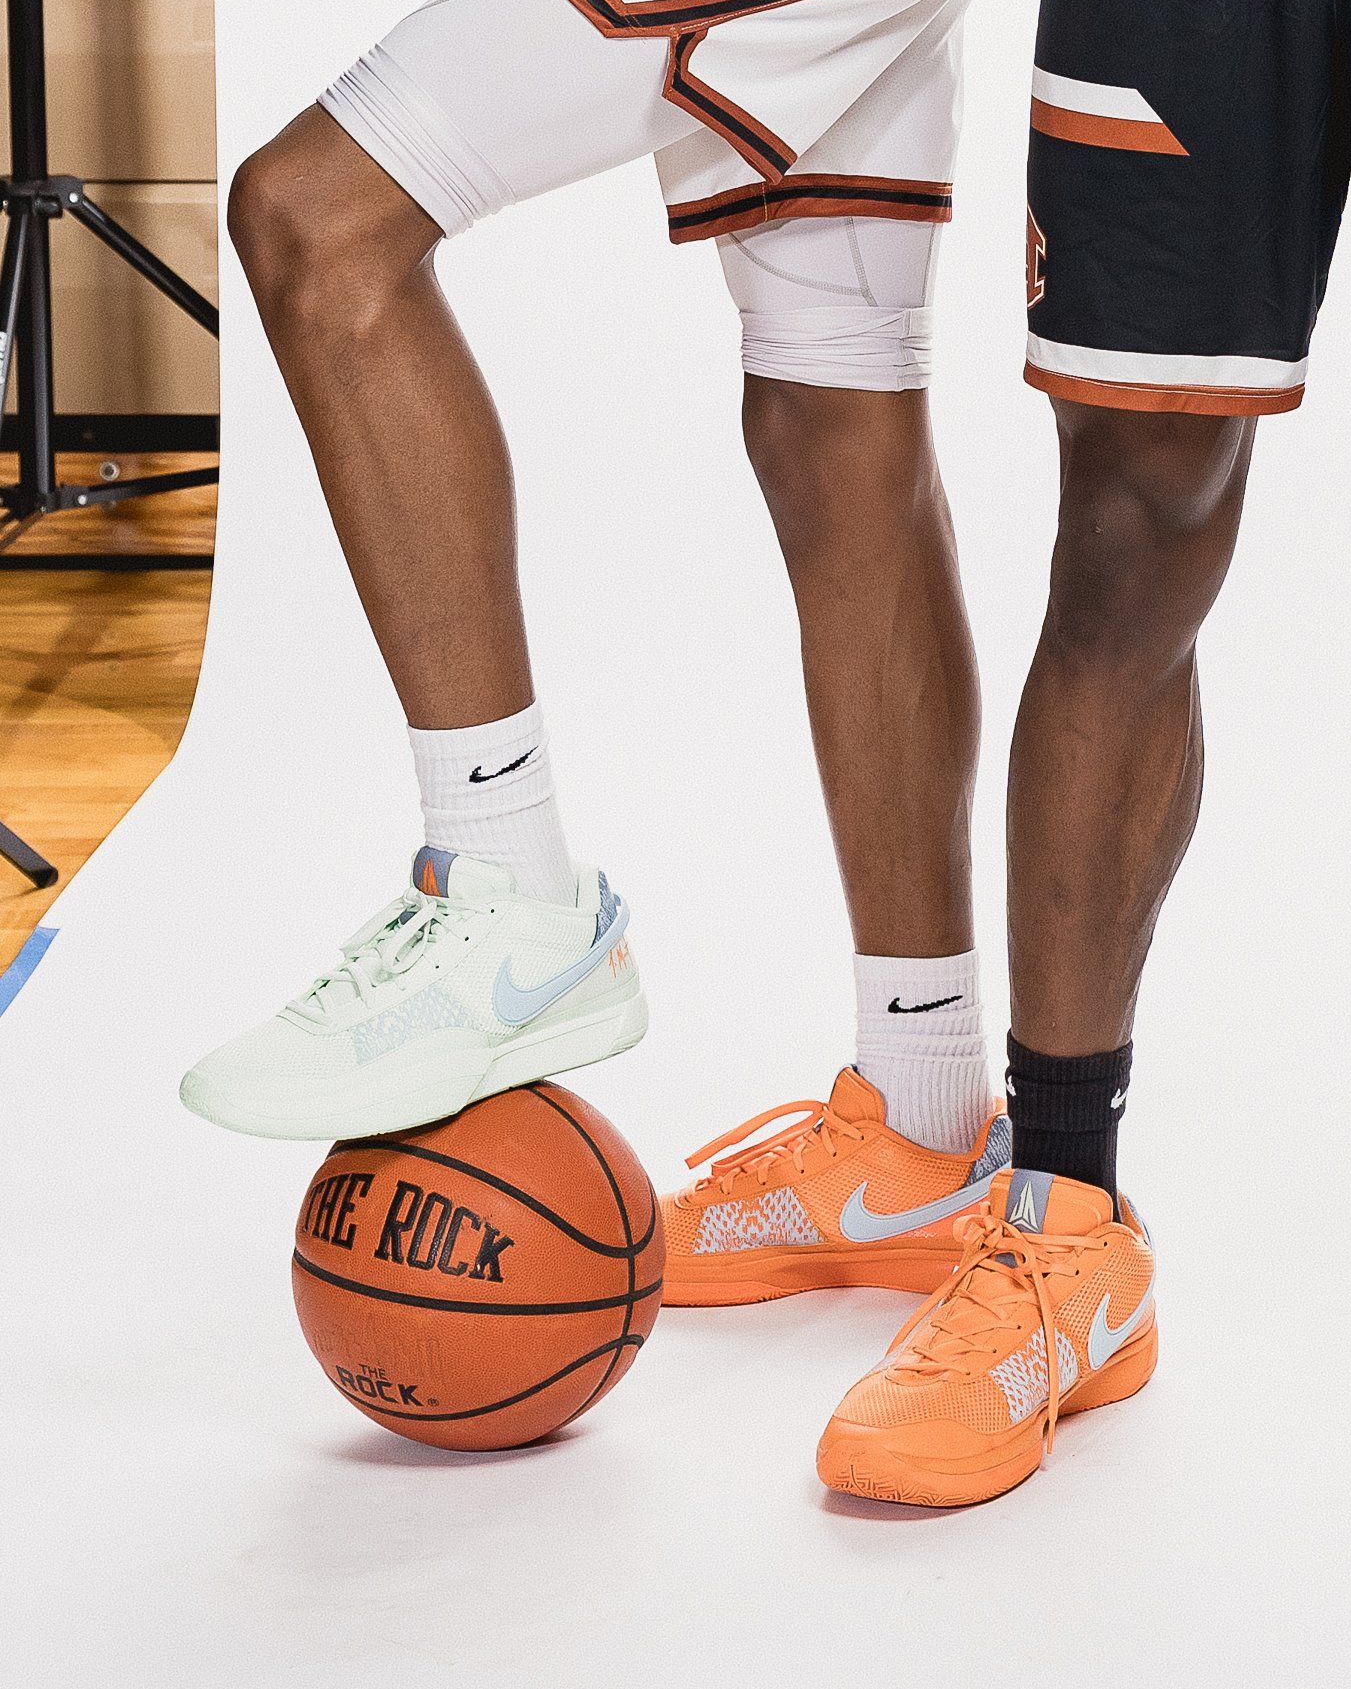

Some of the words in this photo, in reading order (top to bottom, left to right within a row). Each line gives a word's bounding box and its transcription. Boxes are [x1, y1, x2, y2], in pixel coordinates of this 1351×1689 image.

[302, 1172, 376, 1251] THE
[374, 1179, 515, 1283] ROCK
[335, 1364, 424, 1407] ROCK
[358, 1363, 389, 1382] THE
